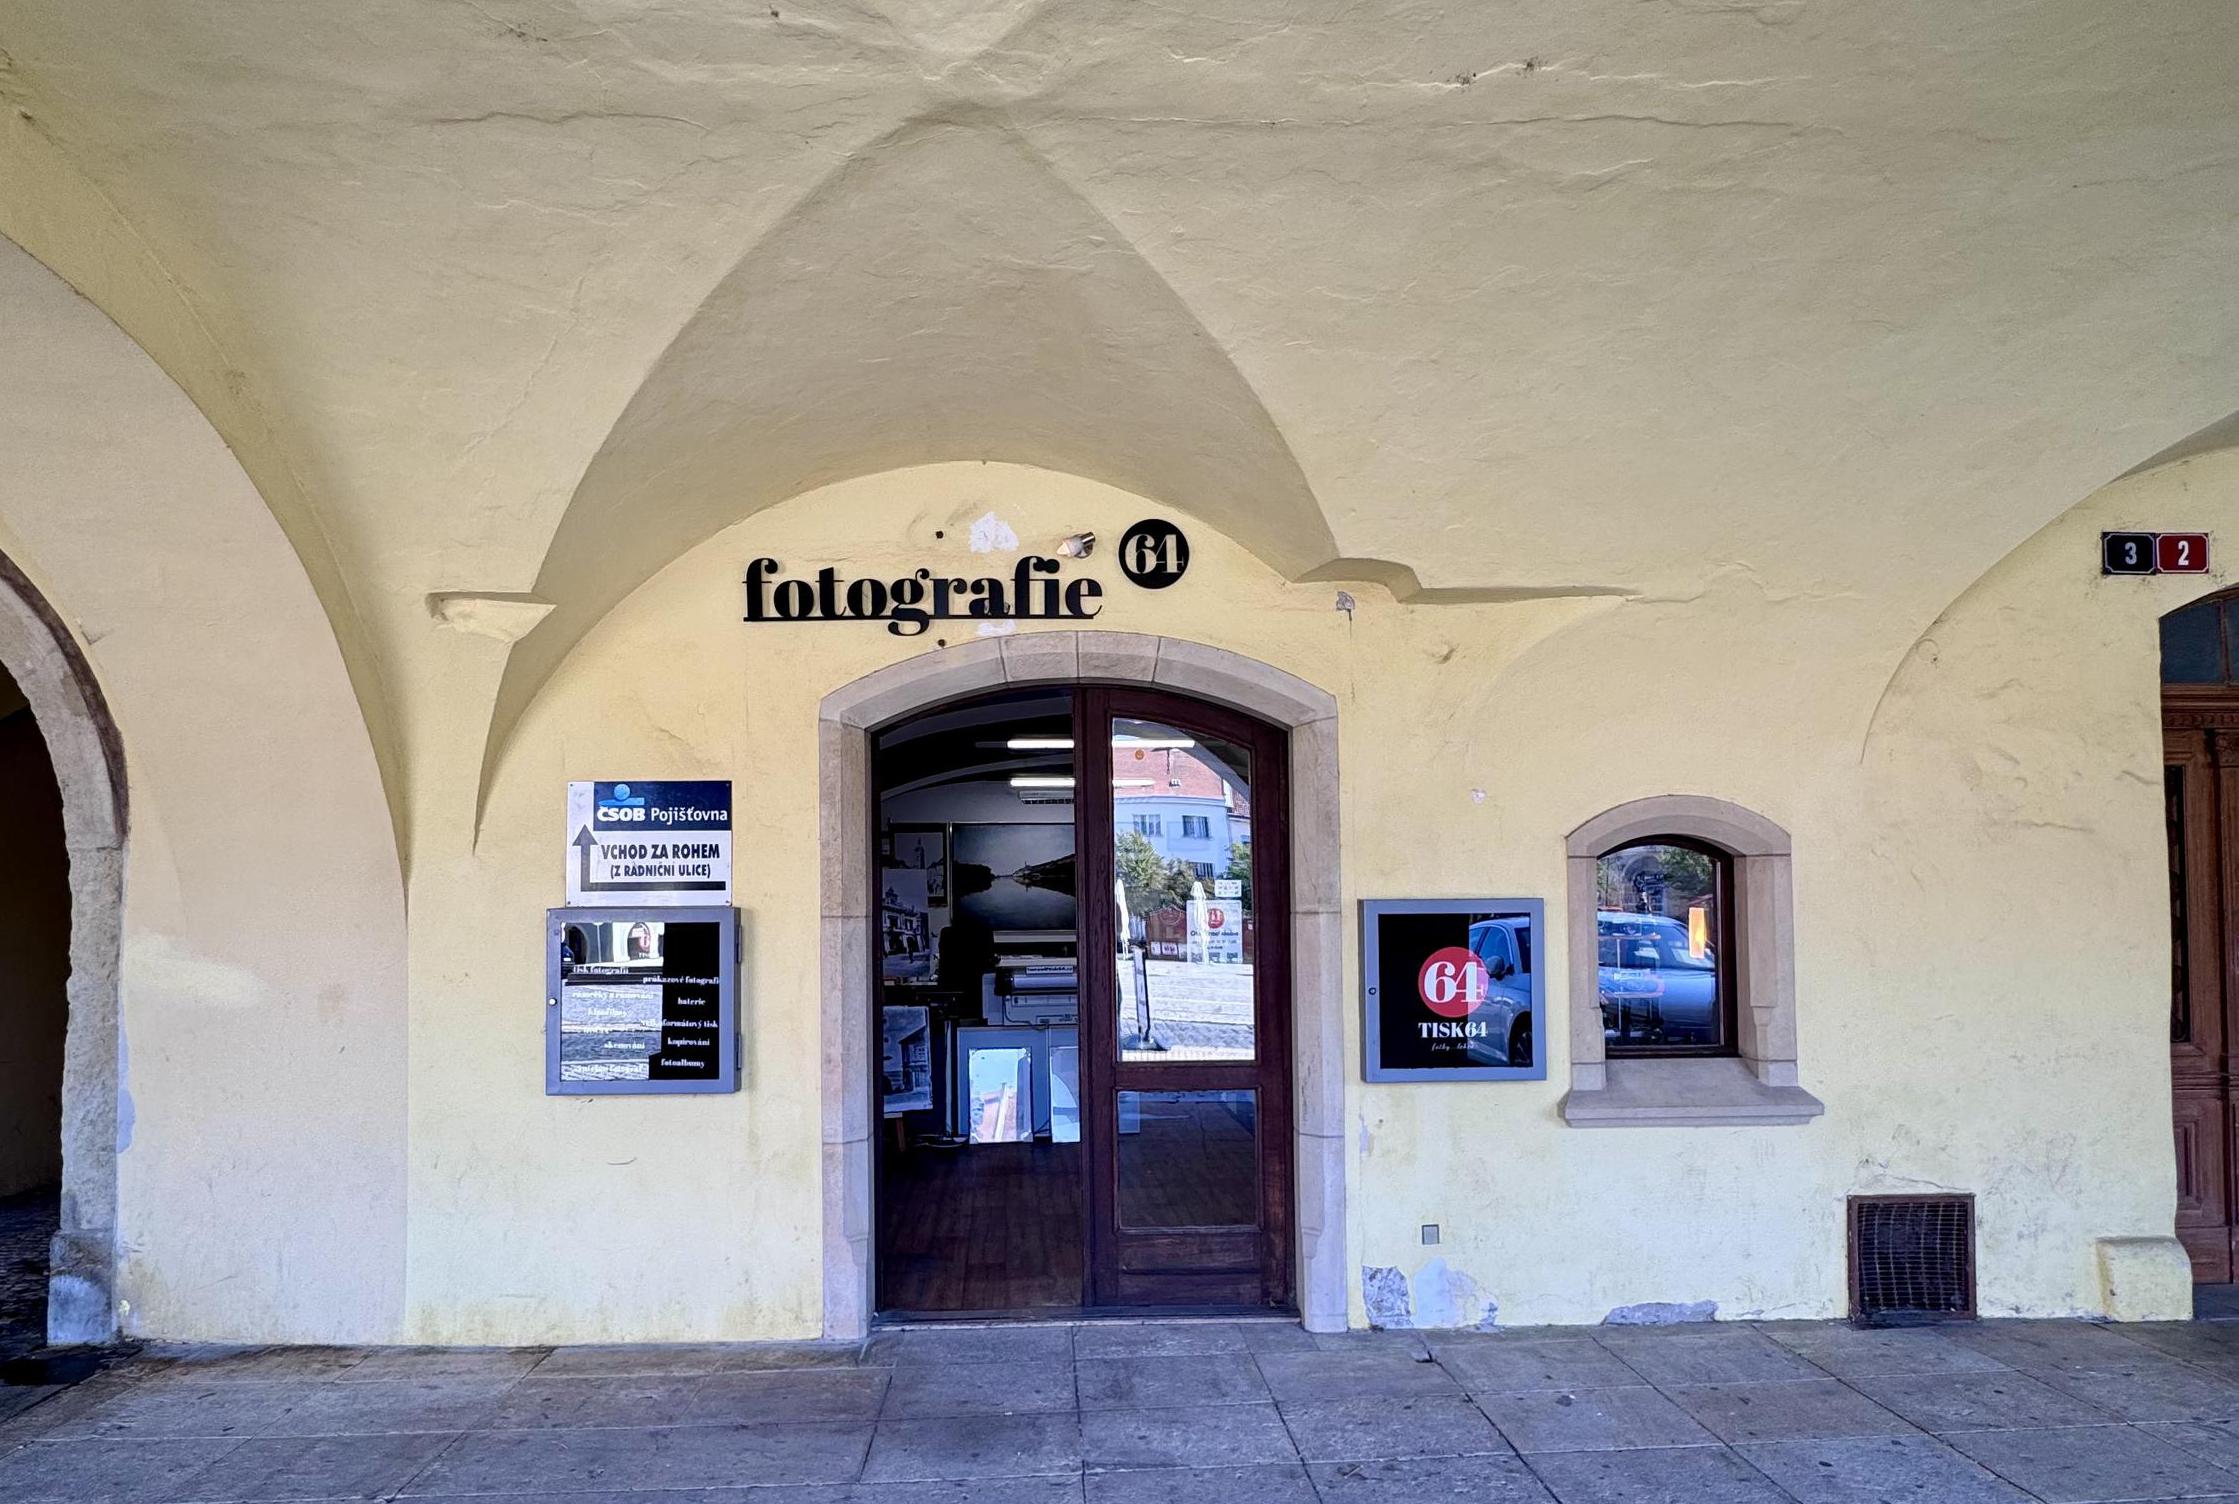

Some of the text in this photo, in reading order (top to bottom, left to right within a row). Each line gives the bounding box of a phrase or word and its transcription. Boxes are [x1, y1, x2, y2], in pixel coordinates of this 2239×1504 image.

[1123, 532, 1185, 575] 64
[2124, 541, 2137, 565] 3
[2177, 540, 2190, 566] 2
[742, 556, 1104, 637] fotografie
[597, 806, 728, 825] ČSOB Pojišťovna
[601, 843, 720, 860] VCHOD ZA ROHEM
[610, 864, 621, 879] (Z
[679, 864, 711, 878] ULICE)
[1424, 961, 1484, 1003] 64
[677, 997, 706, 1005] baterie
[1418, 1021, 1488, 1038] TISK64
